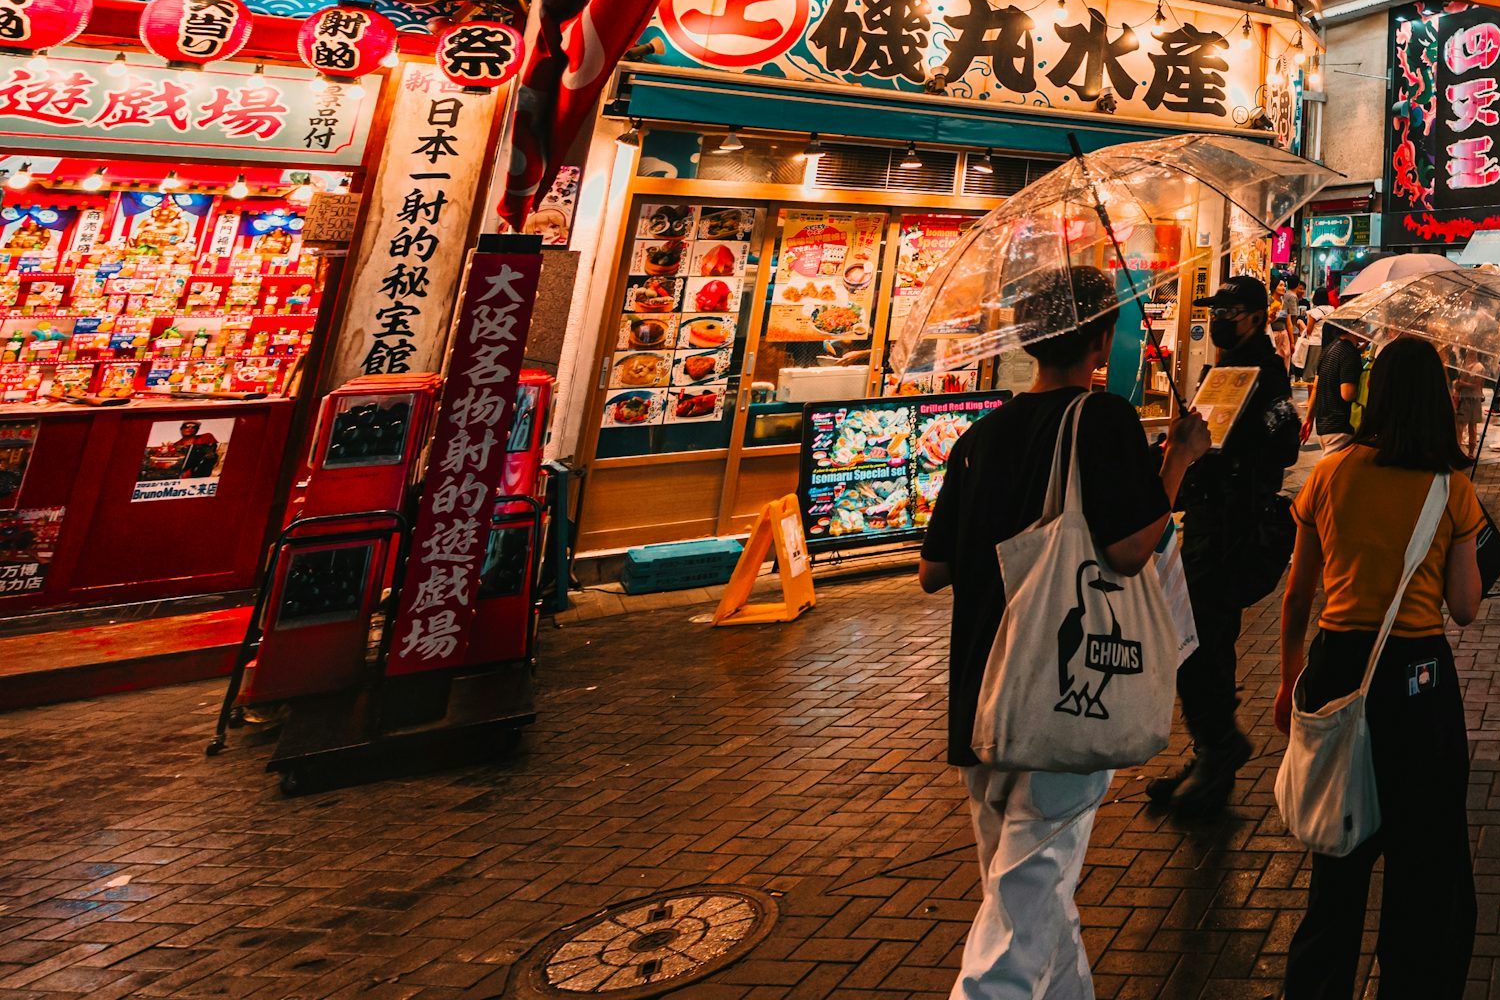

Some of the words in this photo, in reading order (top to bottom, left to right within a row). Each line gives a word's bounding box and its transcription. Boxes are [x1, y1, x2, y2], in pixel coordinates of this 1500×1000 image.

[445, 27, 514, 78] 祭
[303, 84, 347, 150] 景品付
[360, 97, 465, 375] 日本一射的秘宝館
[916, 237, 956, 250] Specia
[920, 403, 948, 414] Grilled
[949, 402, 964, 411] Red
[965, 401, 983, 411] King
[398, 263, 526, 661] 大阪名物射的遊戯場
[811, 470, 853, 485] Isomaru
[854, 467, 890, 482] Special
[890, 465, 907, 478] set
[1089, 640, 1140, 670] CHUMS
